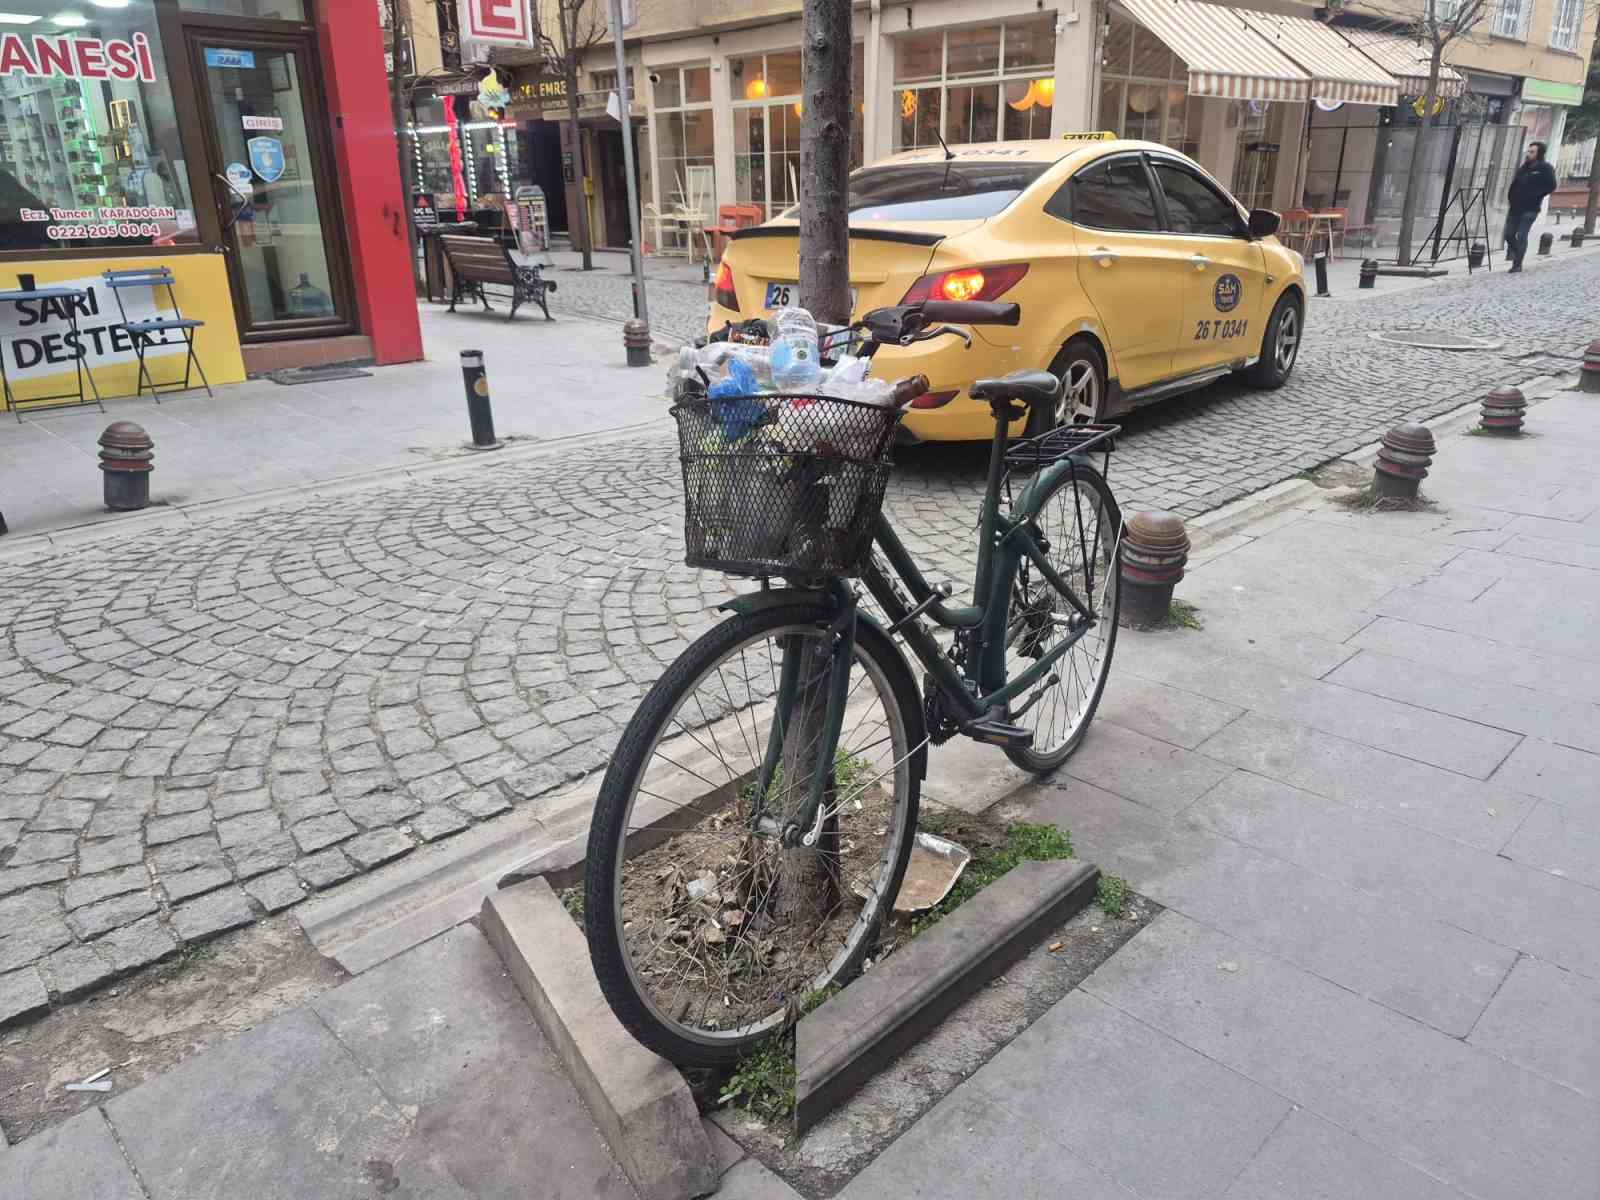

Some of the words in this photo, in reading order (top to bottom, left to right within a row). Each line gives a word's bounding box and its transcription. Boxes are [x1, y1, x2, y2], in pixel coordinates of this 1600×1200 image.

[20, 208, 49, 221] Ecz.
[51, 208, 94, 220] Tuncer
[47, 226, 88, 239] 0222
[771, 286, 791, 306] 26
[1194, 319, 1211, 340] 26
[1213, 319, 1222, 339] T
[1221, 318, 1248, 338] 0341
